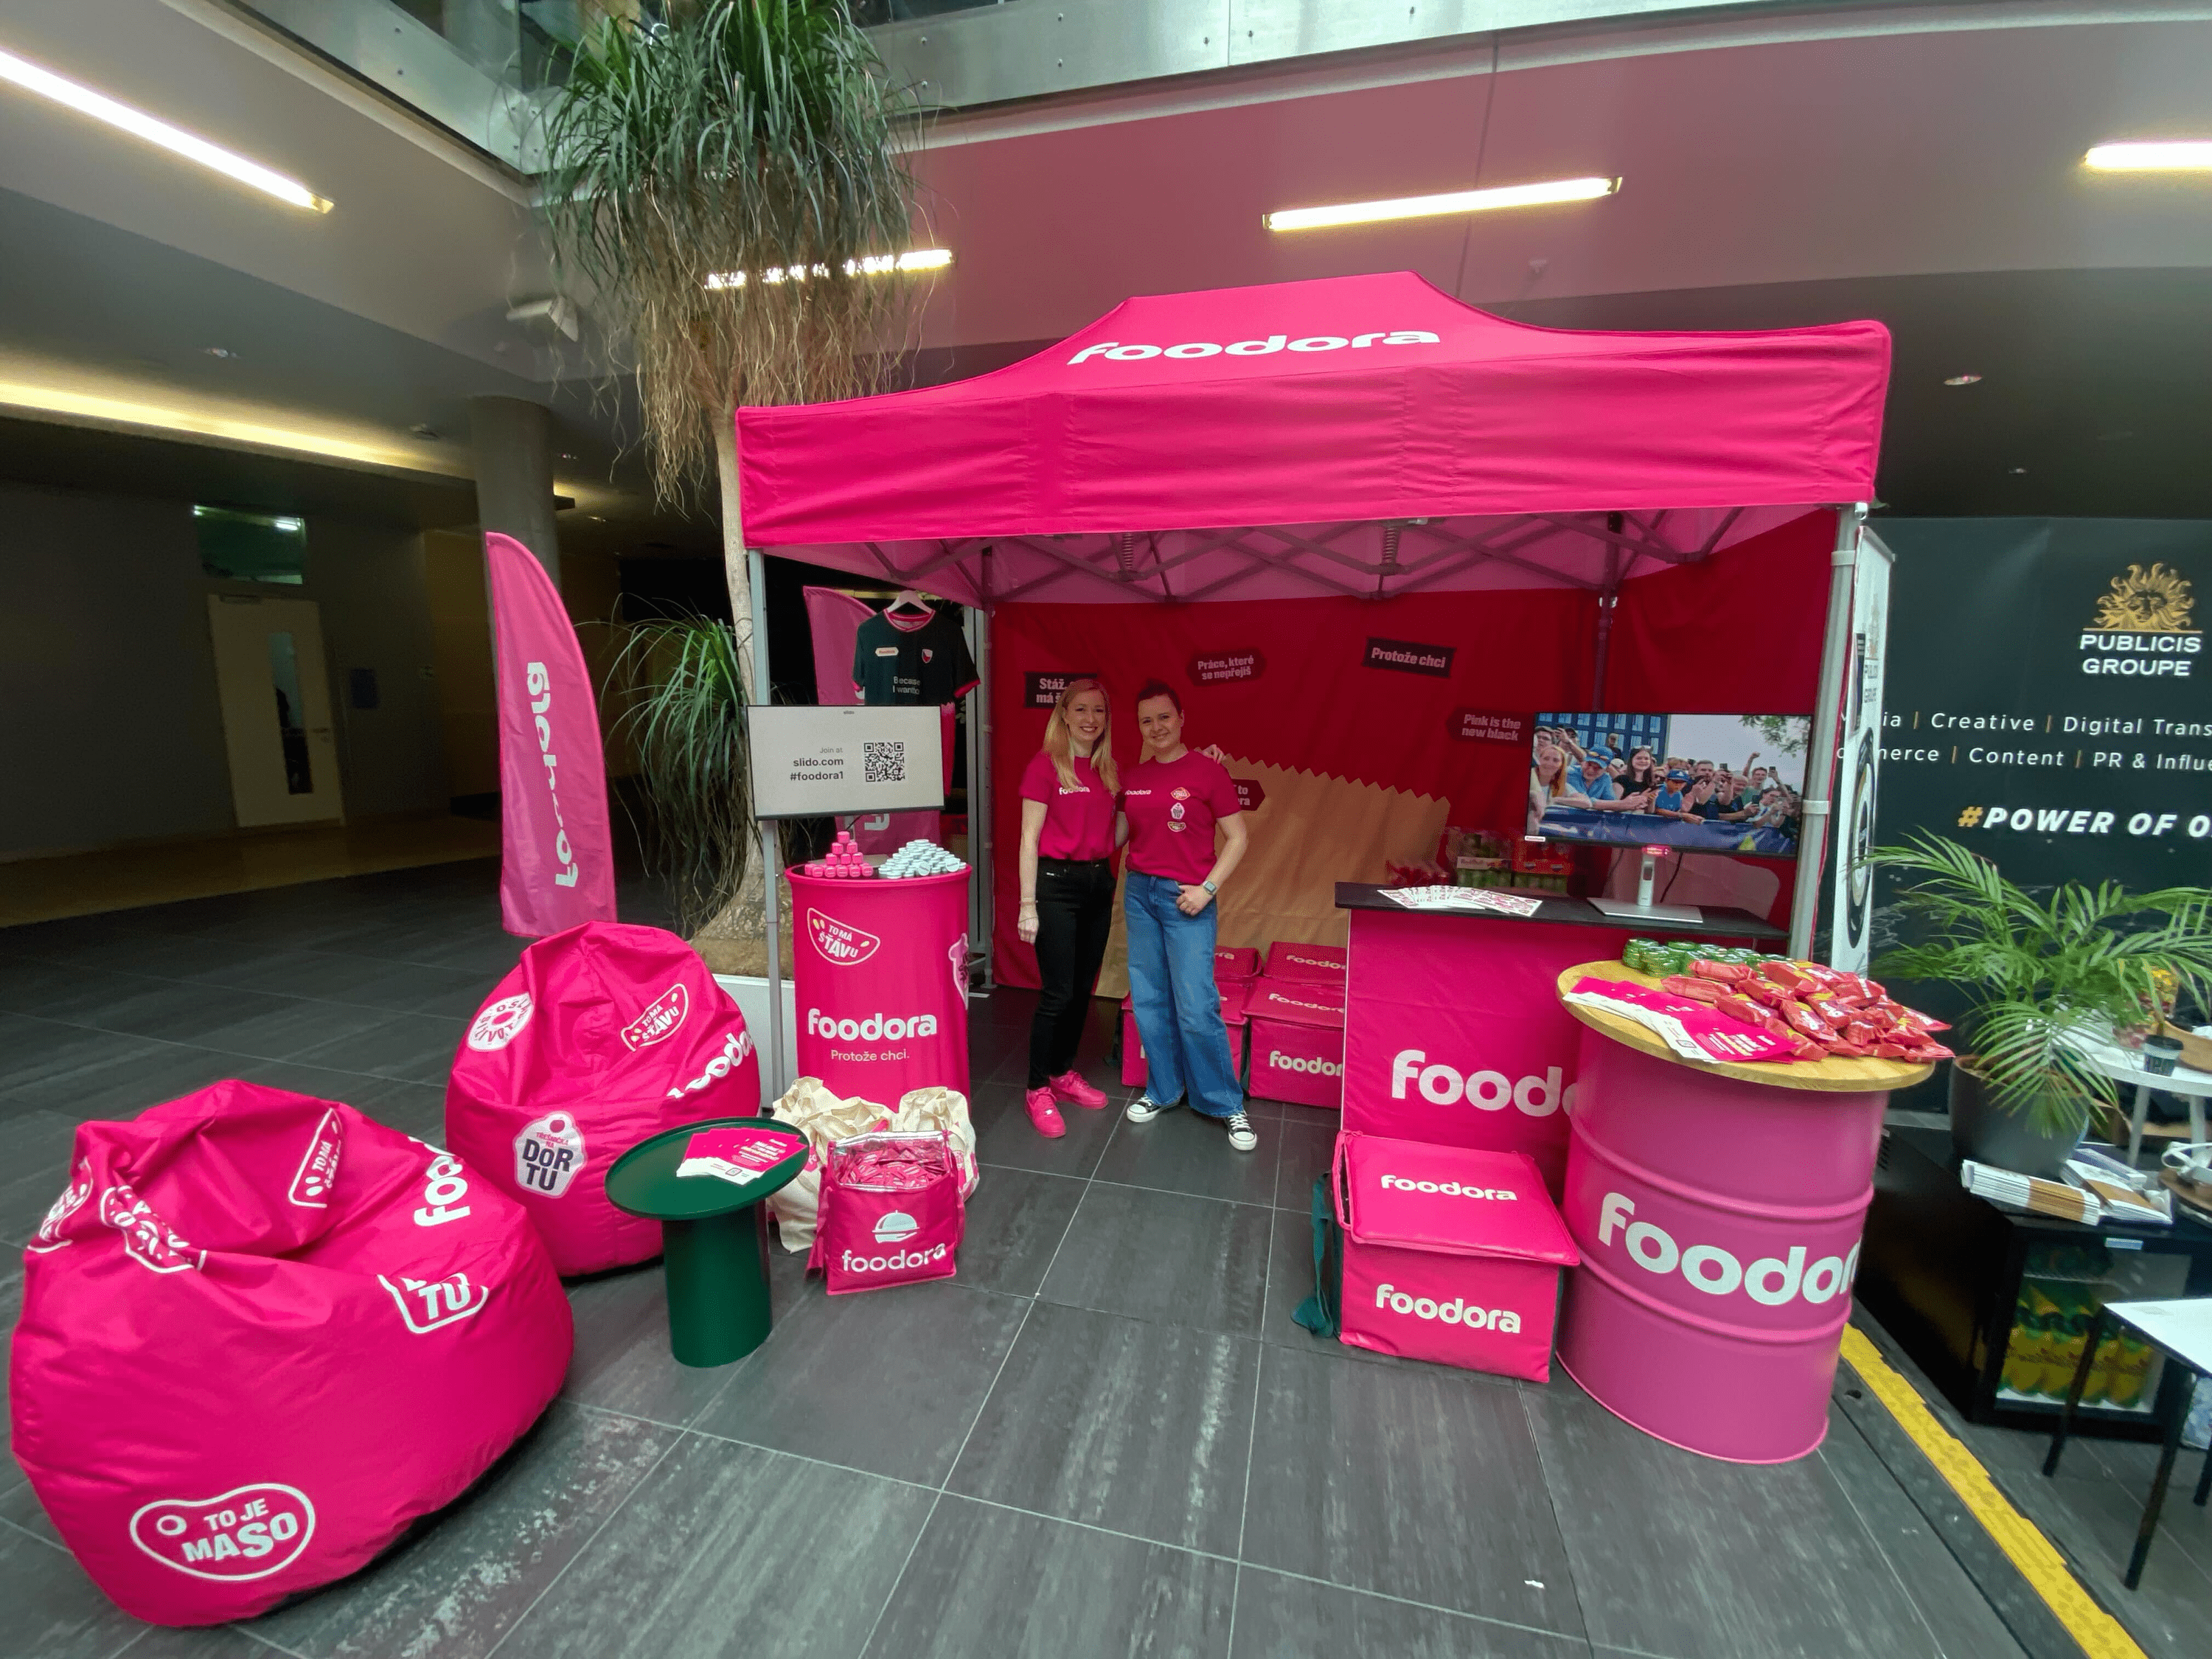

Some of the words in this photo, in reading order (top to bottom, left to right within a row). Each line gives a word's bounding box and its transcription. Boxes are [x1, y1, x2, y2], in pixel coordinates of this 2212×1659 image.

[1067, 330, 1441, 365] foodora
[2079, 634, 2202, 653] PUBLICIS
[1371, 647, 1418, 664] Protože
[1419, 653, 1446, 668] chci
[2082, 658, 2192, 676] GROUPE
[1464, 714, 1488, 726] Pink
[1489, 716, 1500, 728] is
[1502, 717, 1521, 730] the
[1930, 712, 2034, 731] Creative
[2063, 716, 2142, 736] Digital
[2153, 718, 2212, 737] Trans
[1461, 726, 1486, 738] new
[1486, 728, 1519, 741] black
[793, 757, 844, 767] slido.com
[1969, 747, 2064, 766] Content
[2093, 751, 2123, 768] PR
[2132, 753, 2146, 769] &
[790, 771, 844, 781] #foodora1
[1058, 787, 1091, 795] fooora
[1957, 806, 2115, 834] #POWER
[2127, 813, 2177, 835] OF
[2187, 815, 2212, 839] O
[828, 924, 839, 935] TO
[641, 1016, 652, 1027] TO
[807, 1007, 937, 1041] foodora
[830, 1048, 877, 1062] Protože
[880, 1048, 910, 1060] chci.
[526, 1162, 558, 1191] TU
[1380, 1174, 1518, 1202] foodora
[841, 1242, 947, 1273] foodora
[1375, 1283, 1521, 1335] foodora
[204, 1509, 237, 1531] TO
[240, 1498, 269, 1522] JE
[181, 1512, 299, 1562] MASO
